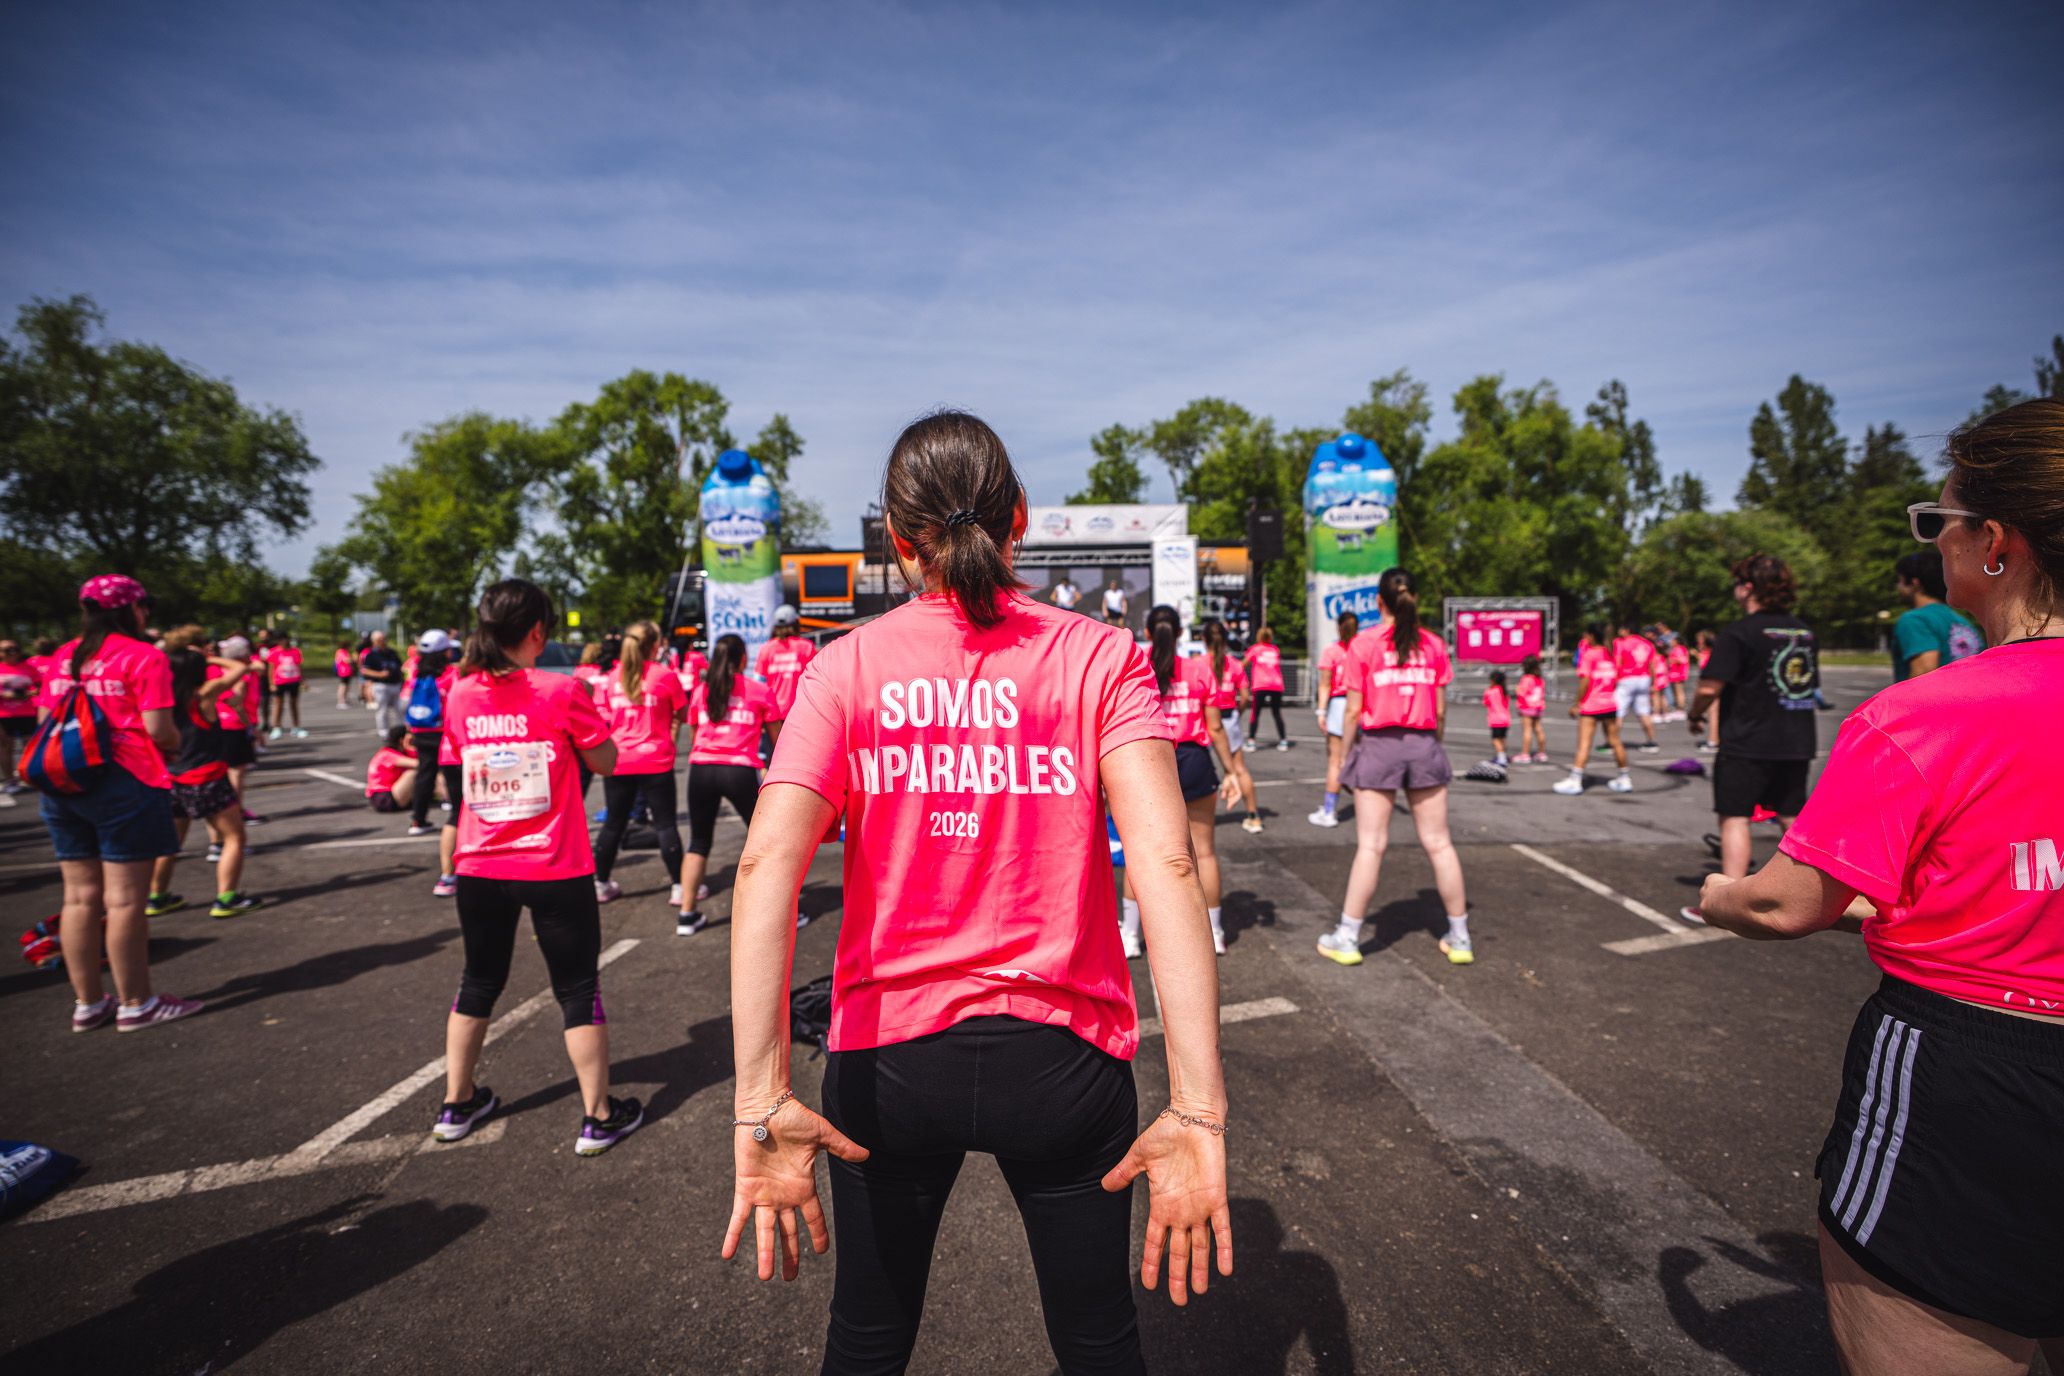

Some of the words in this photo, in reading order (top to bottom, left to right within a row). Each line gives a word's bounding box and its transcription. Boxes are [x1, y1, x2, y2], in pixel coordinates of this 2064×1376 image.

[880, 677, 1019, 730] SOMOS
[465, 714, 529, 739] SOMOS
[848, 743, 1077, 796] IMPARABLES
[929, 811, 980, 838] 2026
